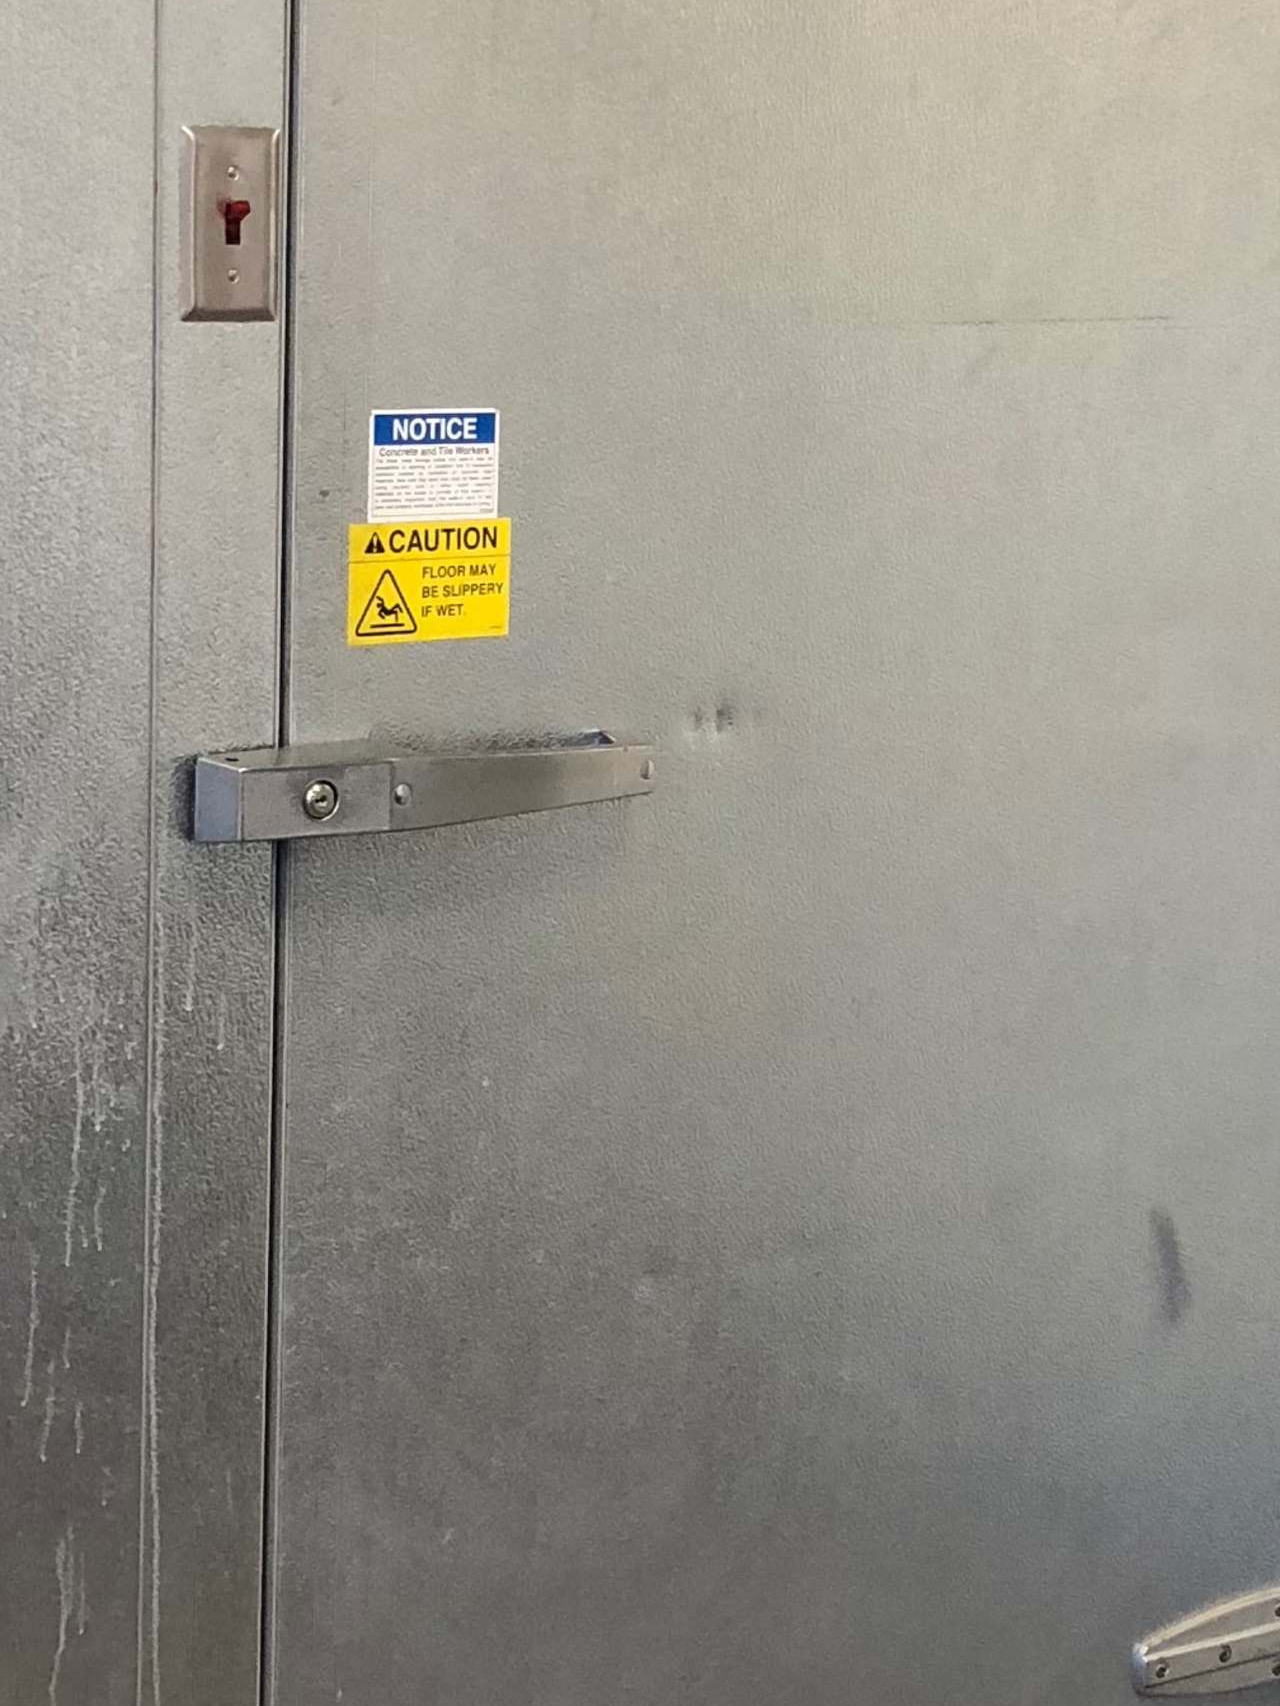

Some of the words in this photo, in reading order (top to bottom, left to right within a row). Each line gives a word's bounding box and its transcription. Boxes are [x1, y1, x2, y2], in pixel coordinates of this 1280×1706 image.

[393, 418, 477, 441] NOTICE
[379, 447, 418, 457] Concrete
[421, 447, 437, 456] and
[438, 446, 453, 455] Tile
[456, 446, 489, 455] Workers
[388, 526, 498, 554] CAUTION
[422, 566, 466, 579] FLOOR
[470, 564, 496, 577] MAY
[422, 585, 438, 598] BE
[442, 582, 503, 597] SLIPPERY
[421, 605, 433, 617] IF
